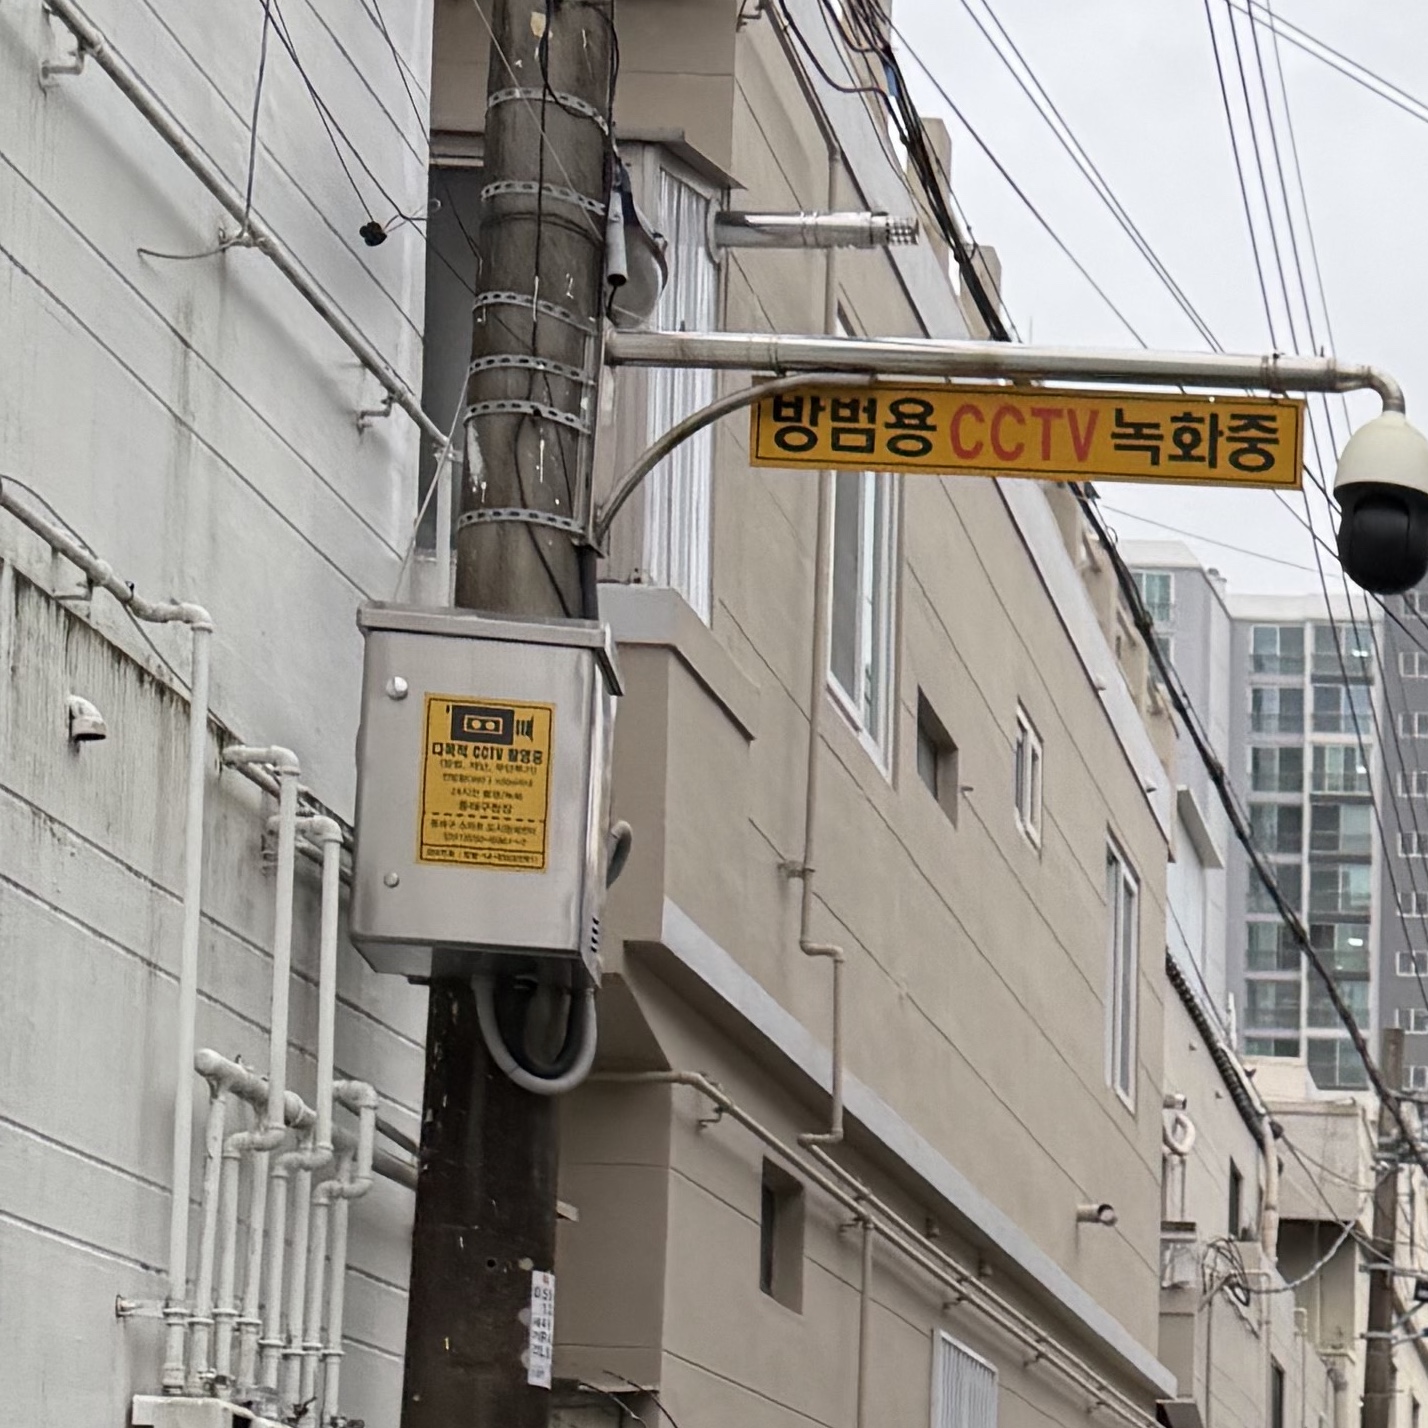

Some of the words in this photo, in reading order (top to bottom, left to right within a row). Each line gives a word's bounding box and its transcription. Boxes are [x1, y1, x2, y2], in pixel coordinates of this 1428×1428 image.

[772, 395, 937, 457] 방범용
[950, 403, 1100, 462] CCTV
[1110, 407, 1280, 473] 녹화중
[472, 745, 504, 761] CCTV
